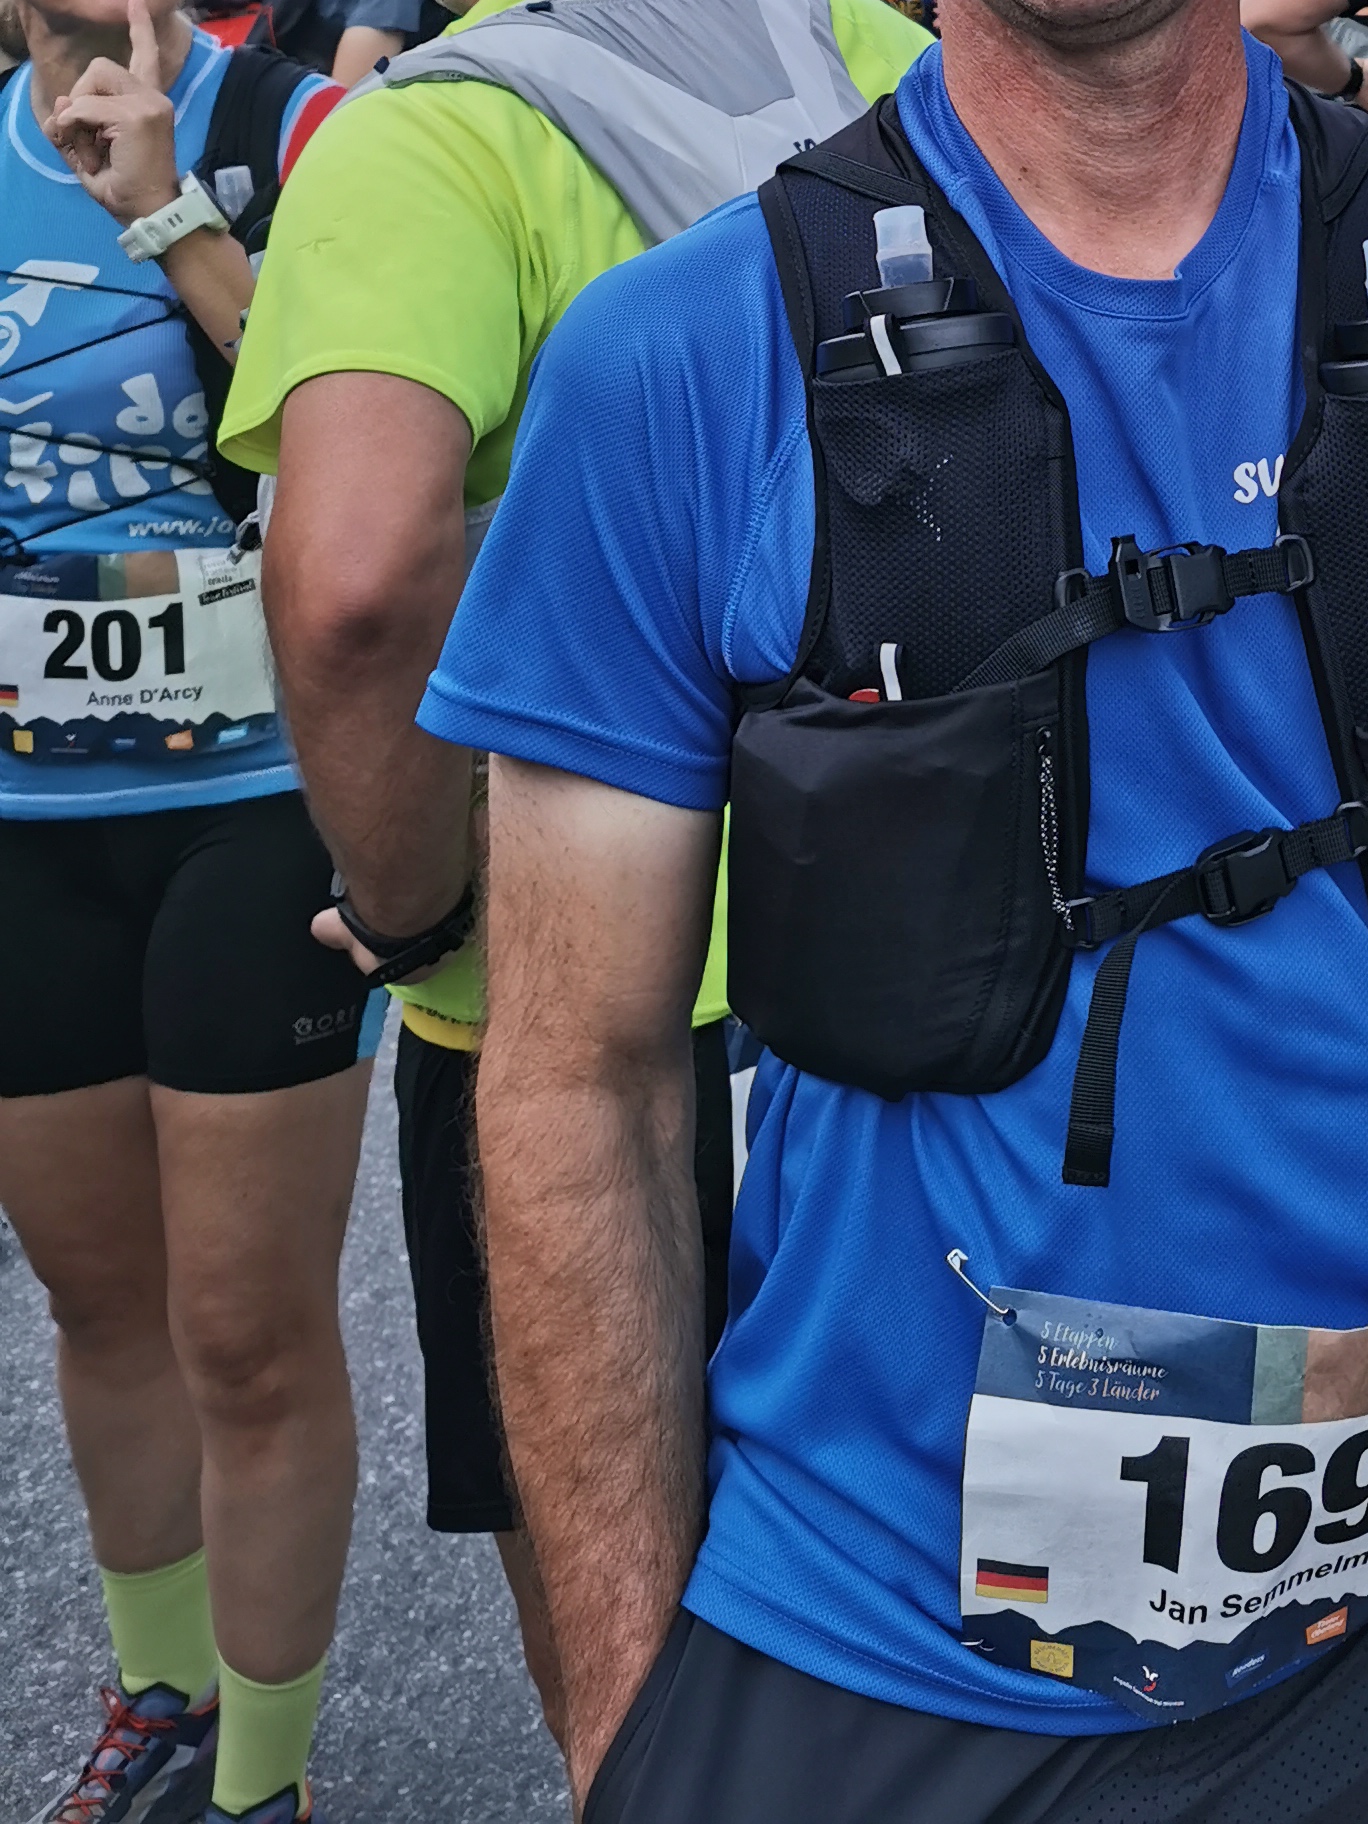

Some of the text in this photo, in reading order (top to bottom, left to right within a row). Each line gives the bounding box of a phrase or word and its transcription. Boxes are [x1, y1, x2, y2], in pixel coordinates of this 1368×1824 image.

[1233, 454, 1285, 504] SV
[43, 602, 186, 682] 201
[86, 691, 134, 707] Anne
[1041, 1321, 1119, 1351] 5 Etappen
[1038, 1345, 1049, 1364] 5
[1035, 1369, 1160, 1402] 5 Tage 3 Länder
[1149, 1589, 1209, 1625] Jan
